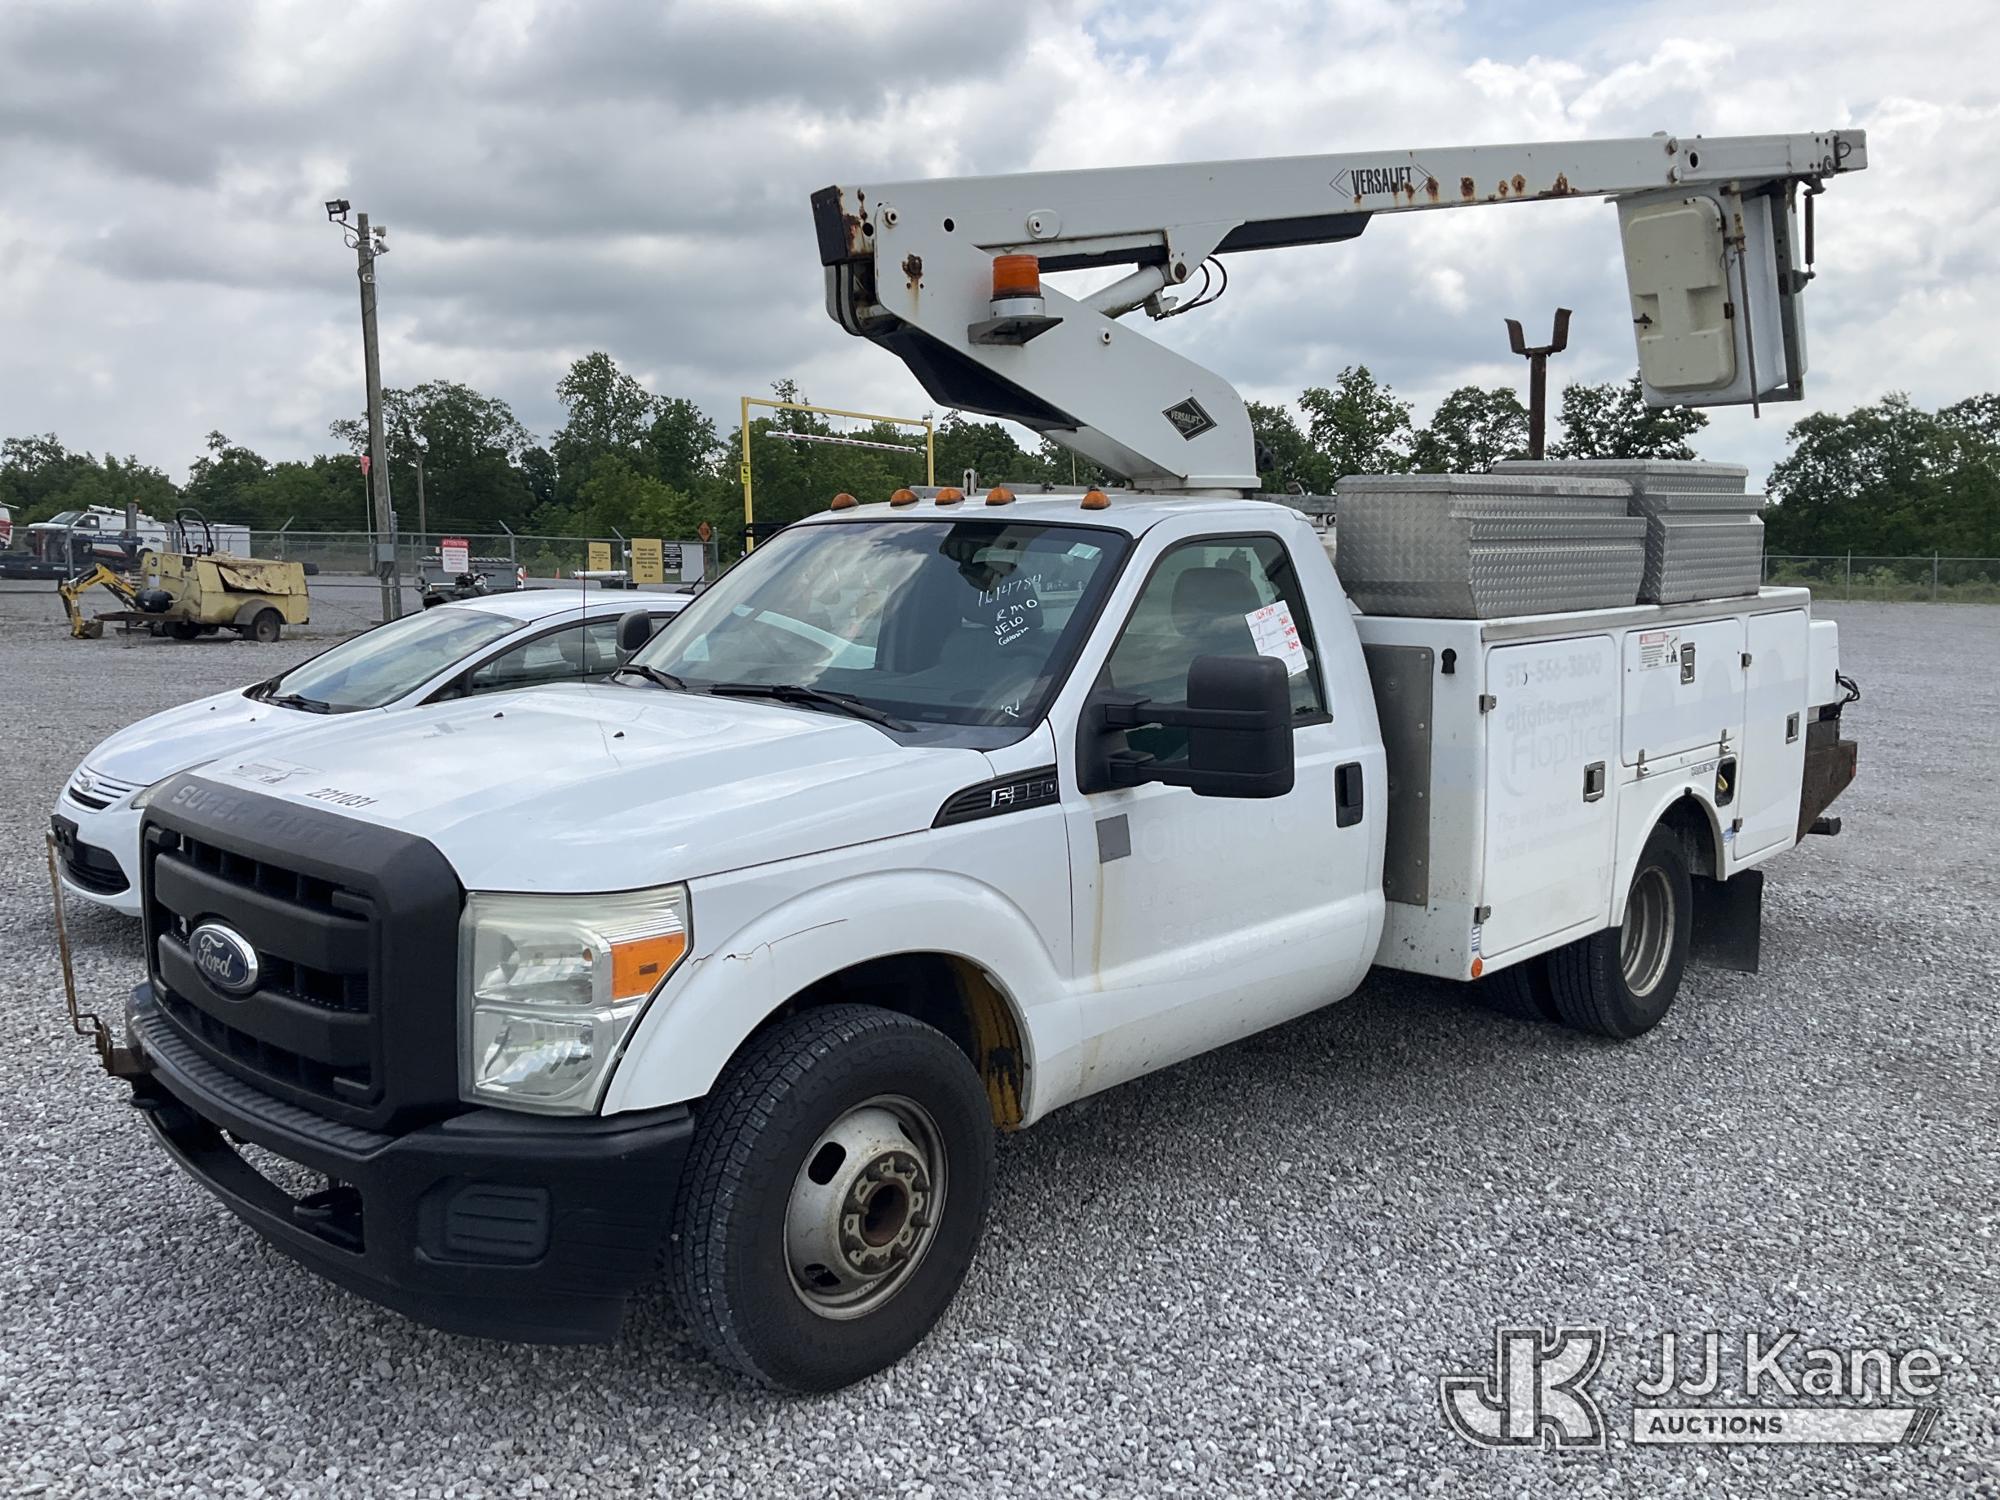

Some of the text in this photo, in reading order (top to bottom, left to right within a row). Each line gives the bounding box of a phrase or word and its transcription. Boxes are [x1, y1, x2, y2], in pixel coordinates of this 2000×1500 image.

[1351, 166, 1412, 195] VERSALIFT
[151, 557, 158, 567] 3
[994, 616, 1024, 636] VELO
[171, 785, 250, 823] SUPER
[306, 787, 378, 808] 2211031
[197, 933, 233, 978] Ford
